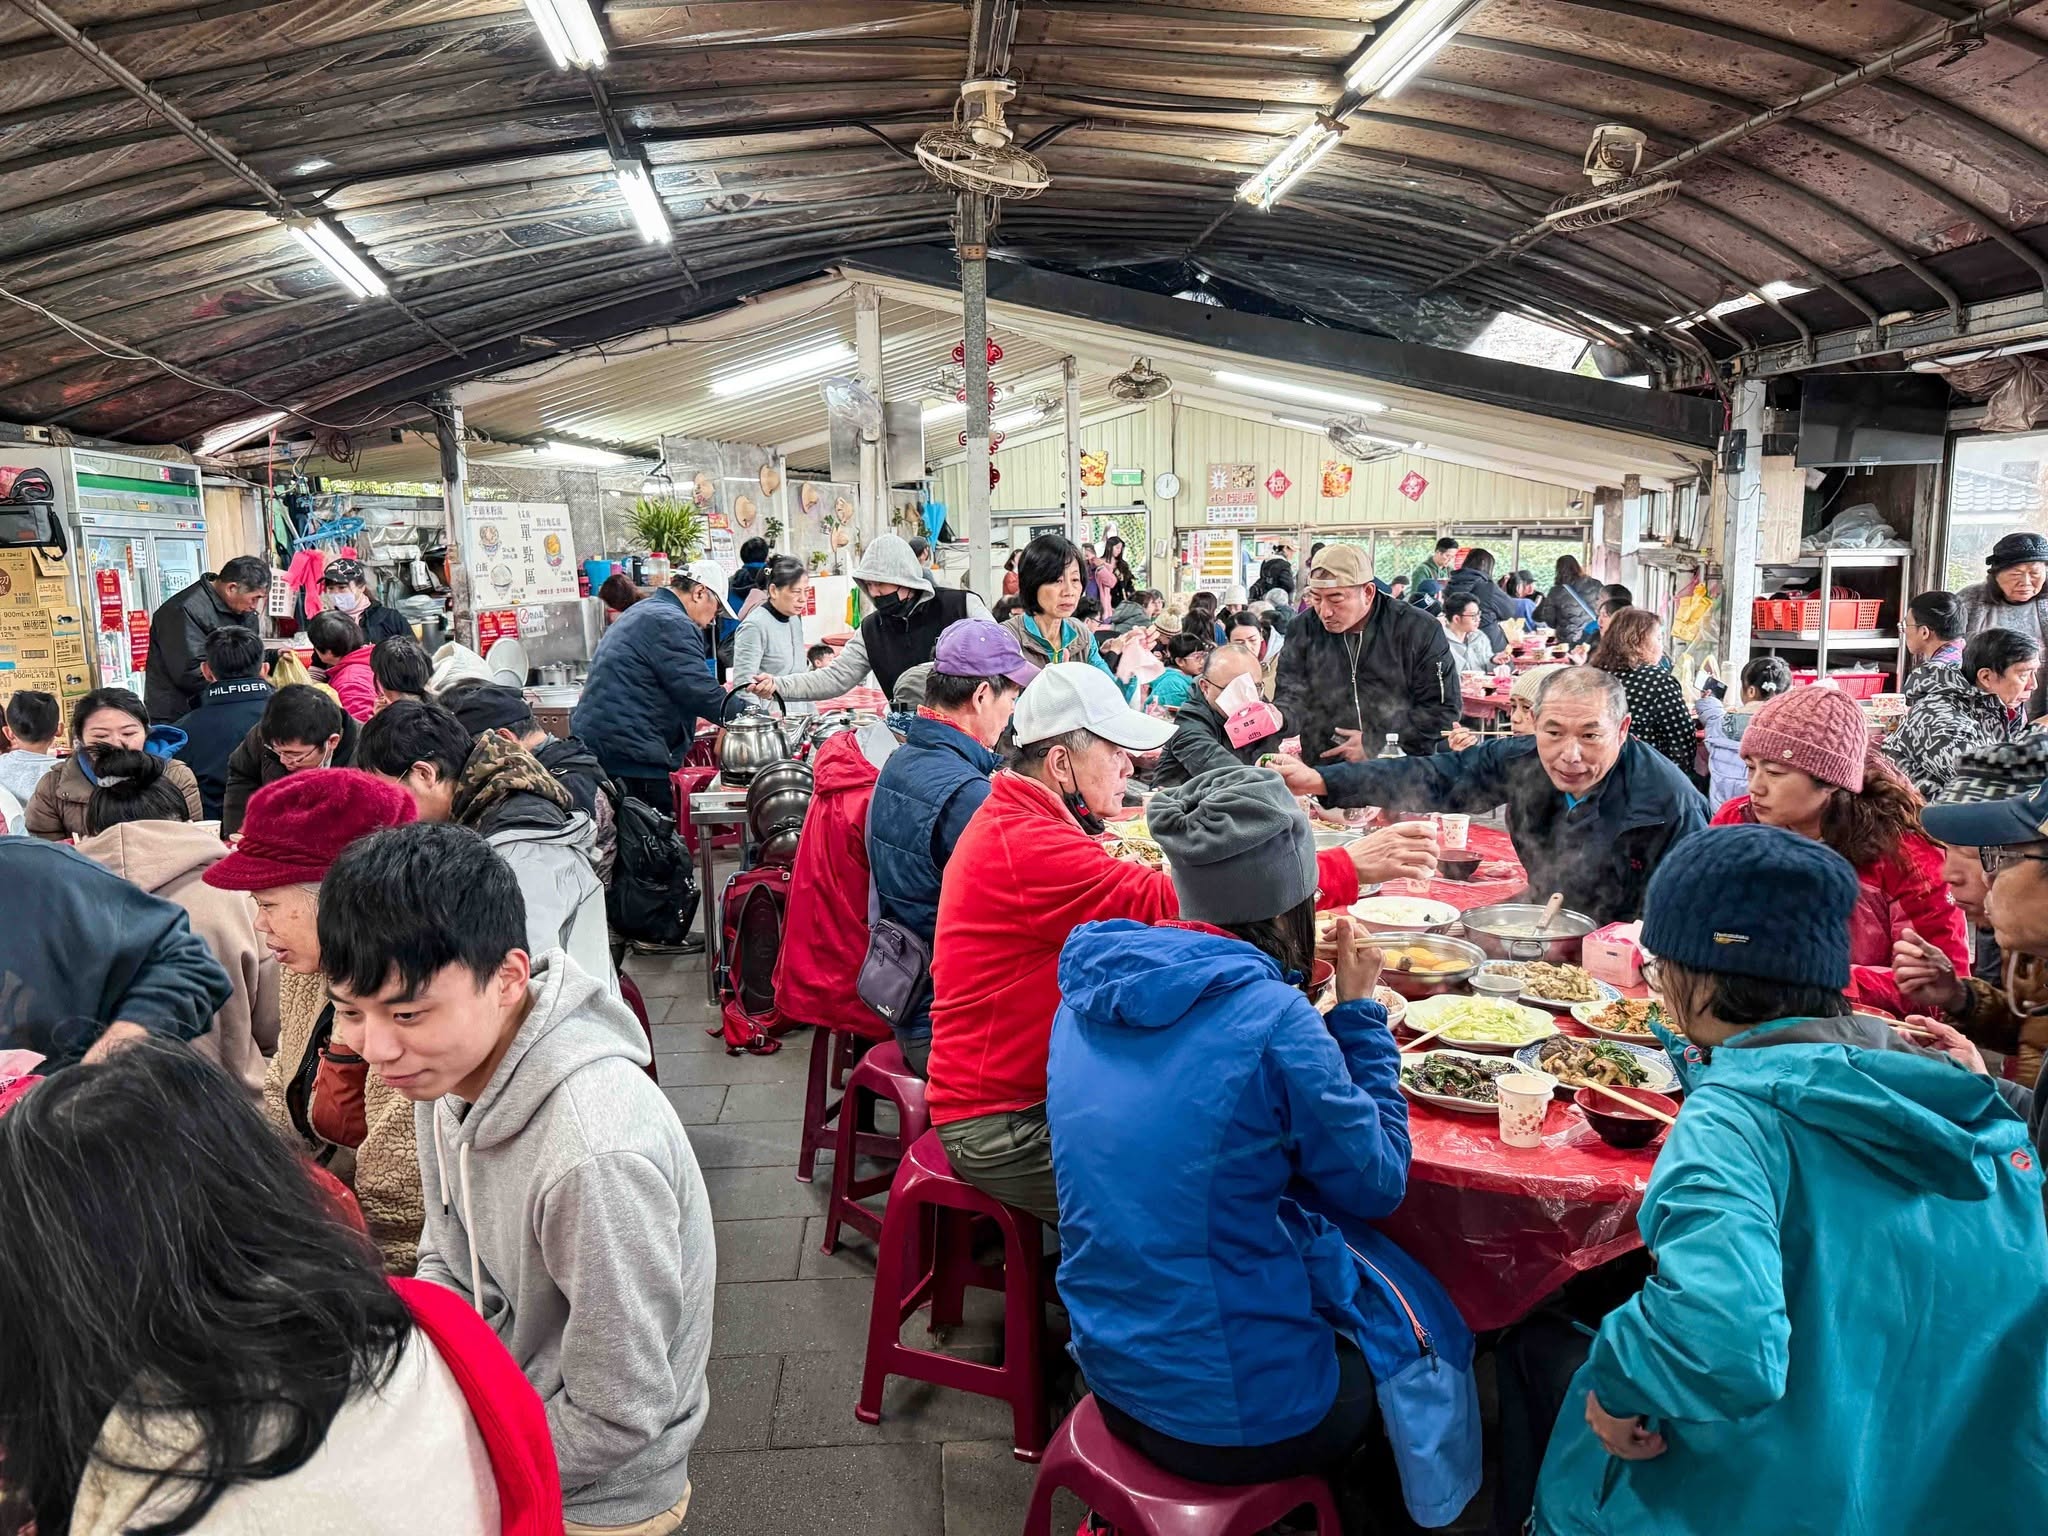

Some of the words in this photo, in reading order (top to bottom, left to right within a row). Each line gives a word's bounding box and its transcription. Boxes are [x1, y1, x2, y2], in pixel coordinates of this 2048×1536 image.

[1268, 476, 1285, 493] 福
[521, 523, 536, 585] 單點區
[209, 682, 267, 697] HILFIGER
